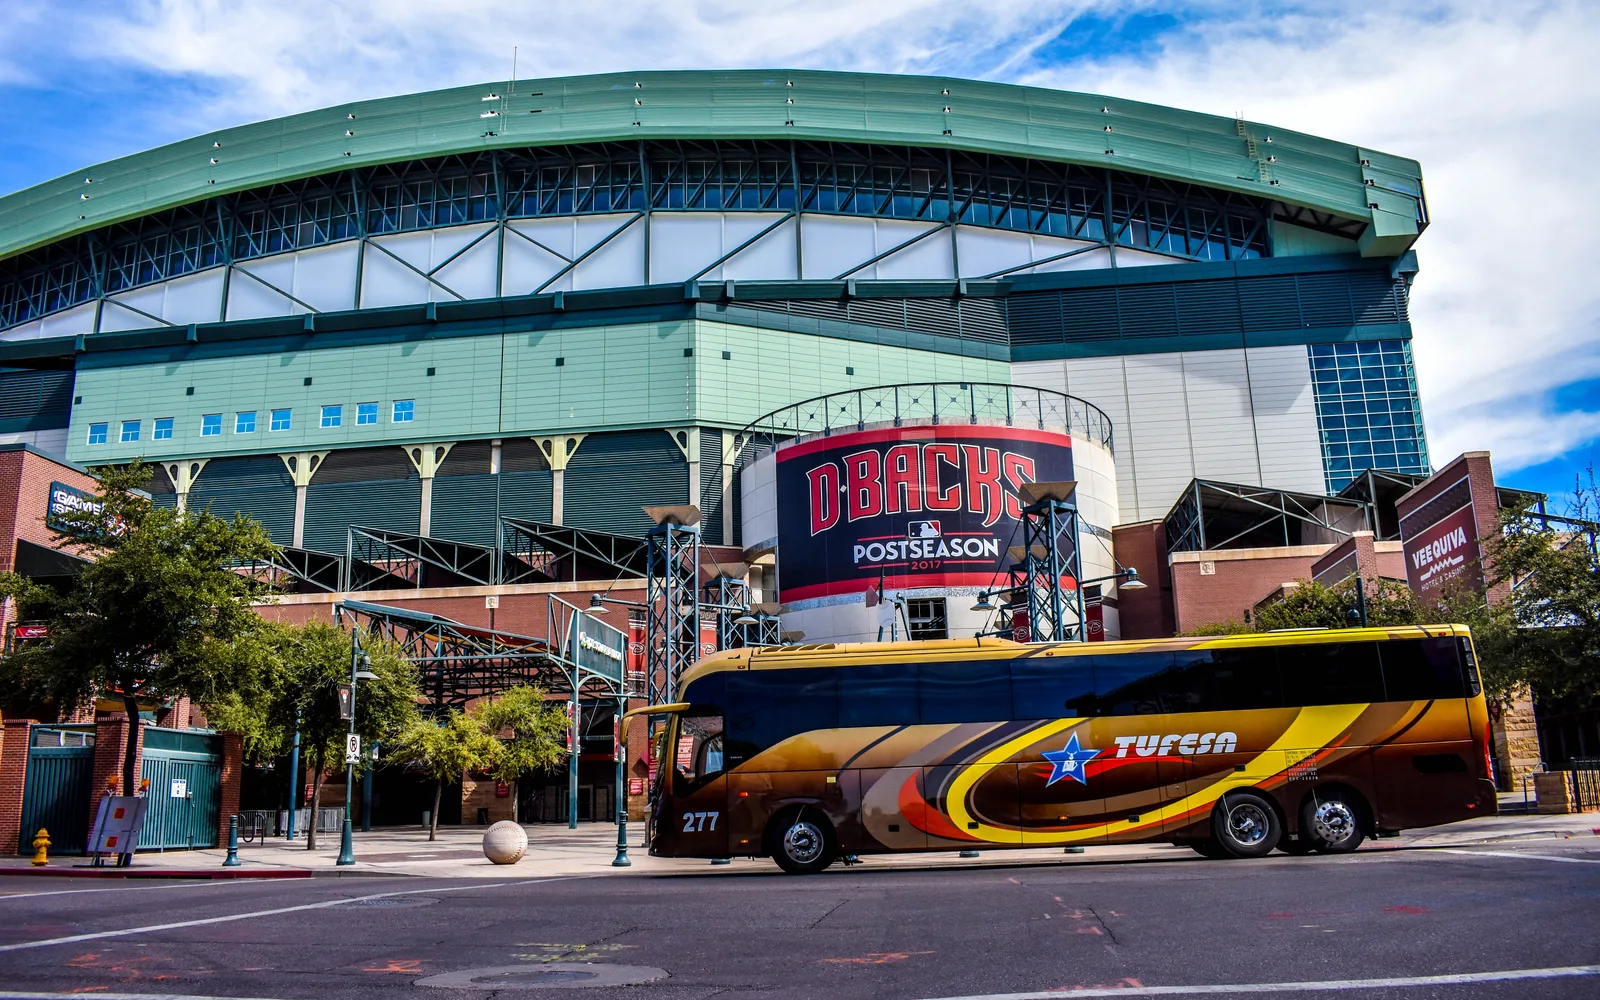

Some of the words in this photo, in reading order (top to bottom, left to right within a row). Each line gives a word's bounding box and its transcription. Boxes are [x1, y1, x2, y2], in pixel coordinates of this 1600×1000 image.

[853, 538, 999, 564] POSTSEASON
[911, 560, 941, 570] 2017
[1114, 731, 1238, 758] TUFESA
[682, 811, 719, 832] 277
